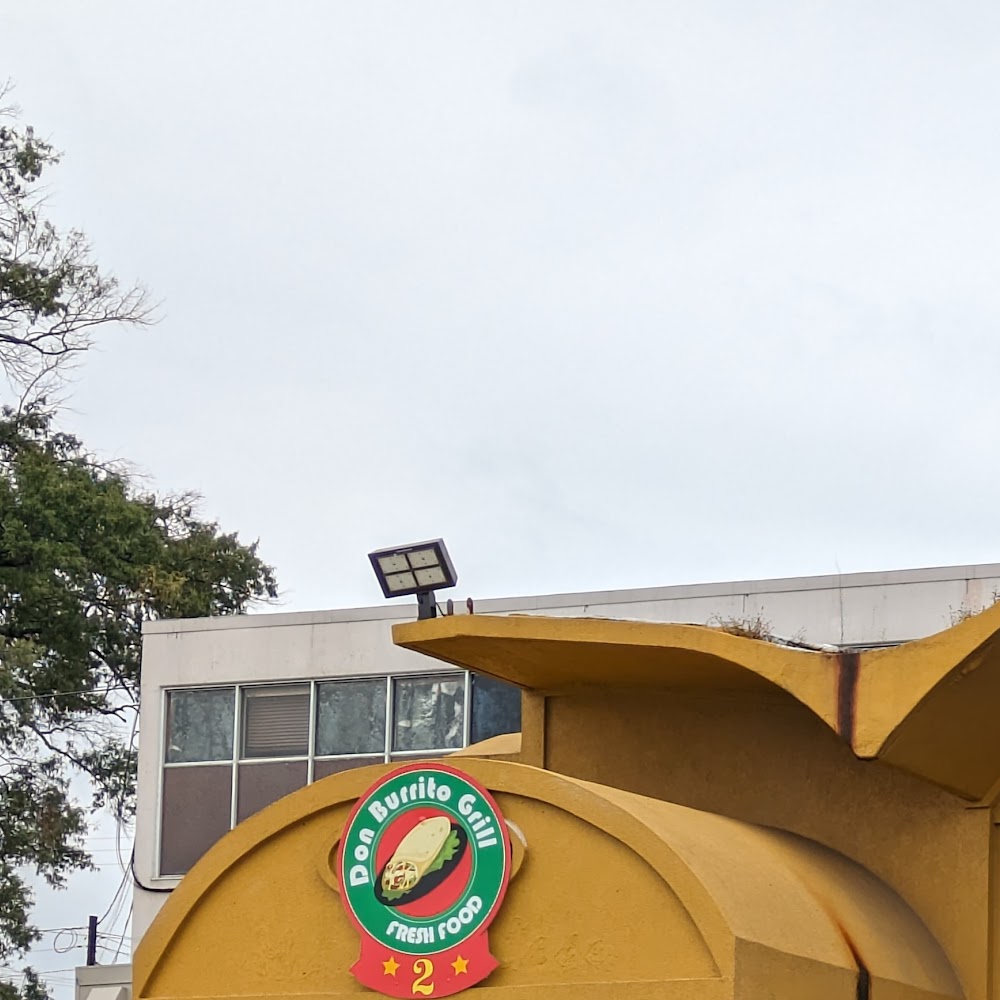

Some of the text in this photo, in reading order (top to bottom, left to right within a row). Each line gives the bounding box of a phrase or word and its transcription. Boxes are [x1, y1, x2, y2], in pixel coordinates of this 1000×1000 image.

[349, 776, 498, 887] Don Burrito Grill
[385, 895, 483, 944] FRESH FOOD
[412, 958, 435, 996] 2
